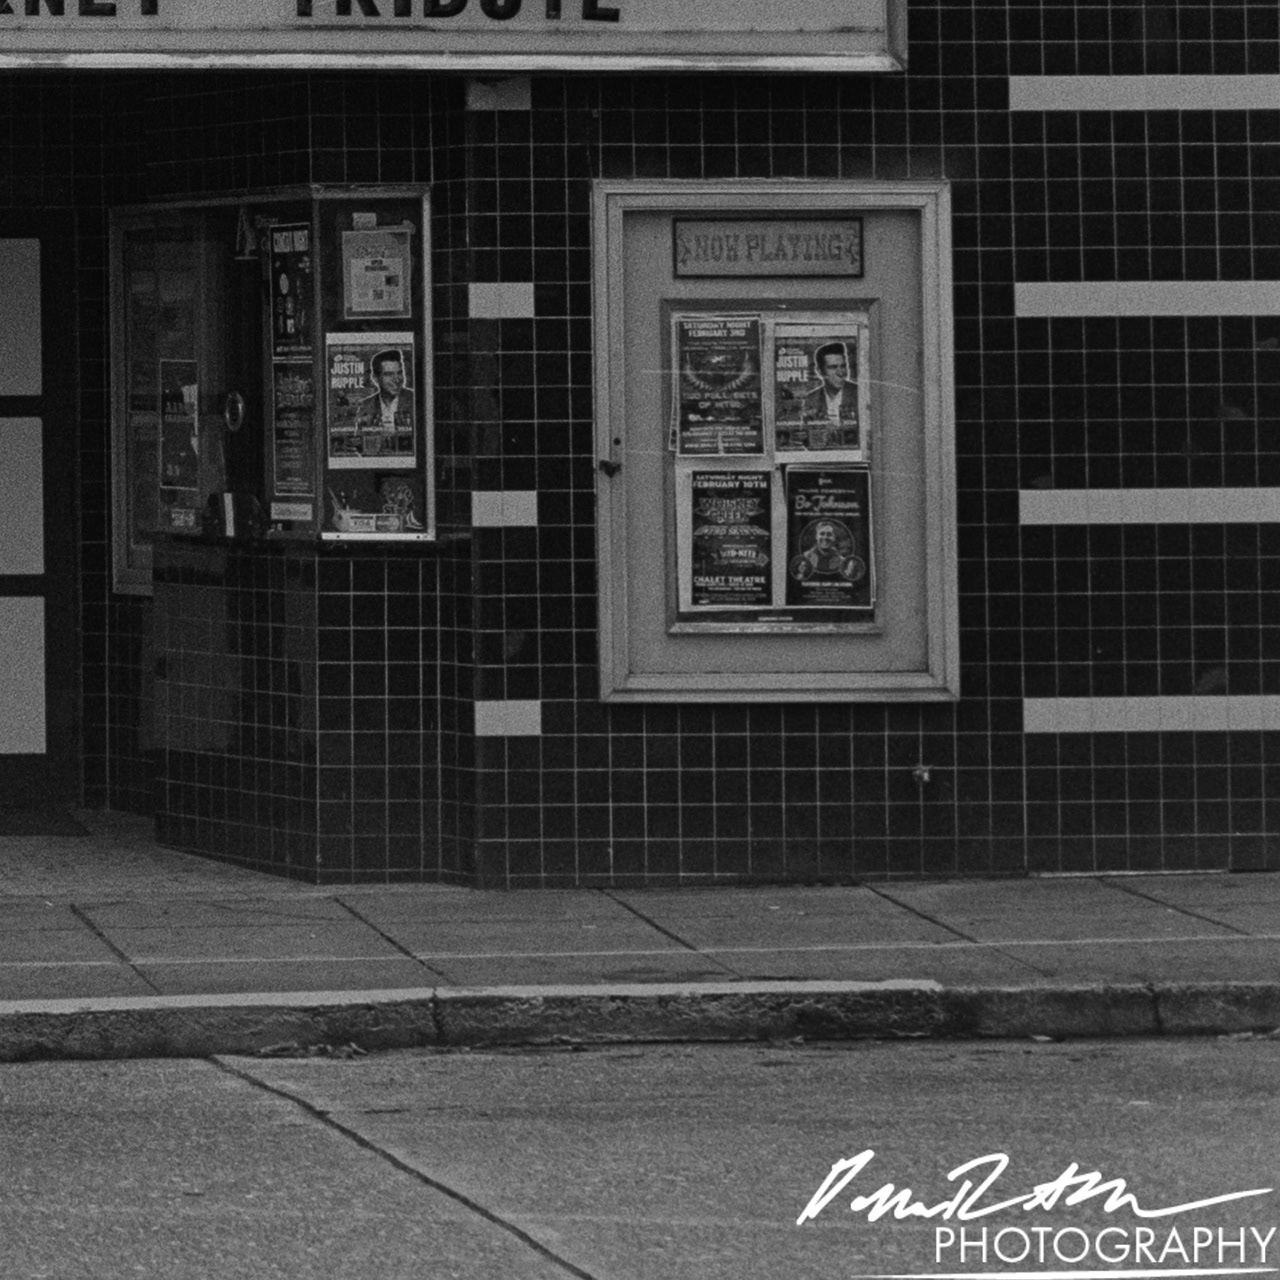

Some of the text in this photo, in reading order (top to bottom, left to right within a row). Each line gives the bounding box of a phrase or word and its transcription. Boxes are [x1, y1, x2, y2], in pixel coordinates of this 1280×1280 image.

[694, 233, 842, 262] NOW PLAYING
[330, 362, 364, 375] JUSTIN
[330, 376, 365, 389] RUPPLE
